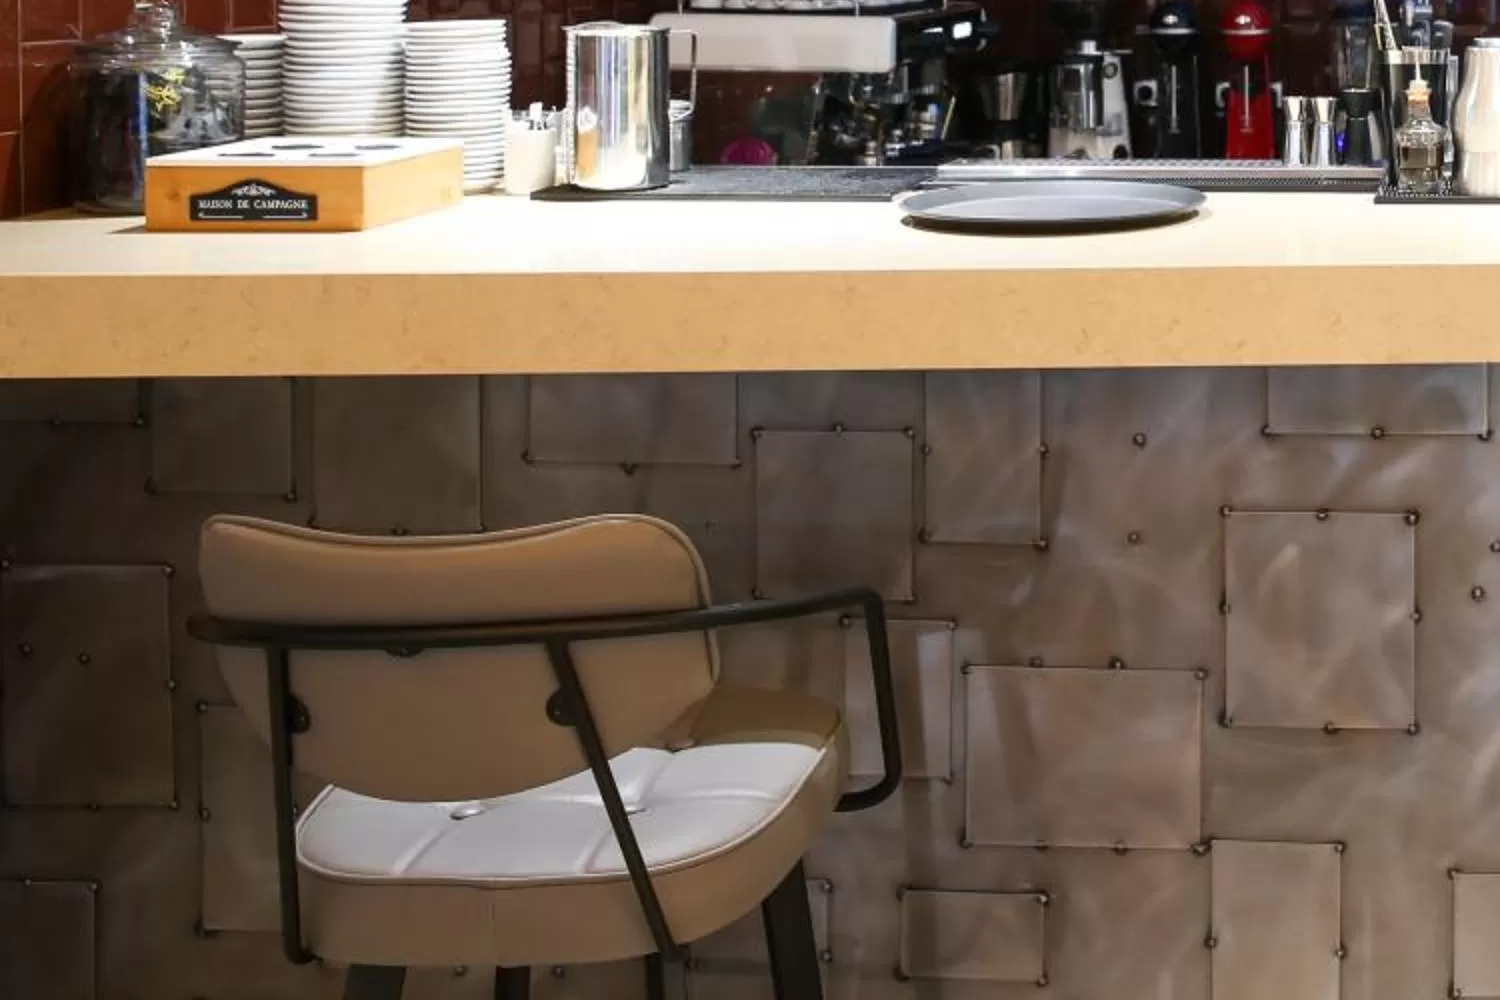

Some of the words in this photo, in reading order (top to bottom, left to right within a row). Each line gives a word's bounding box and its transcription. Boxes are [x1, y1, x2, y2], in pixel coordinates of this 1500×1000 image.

[197, 199, 233, 209] MAISON
[236, 199, 249, 209] DE
[253, 199, 309, 209] CAMPAGNE
